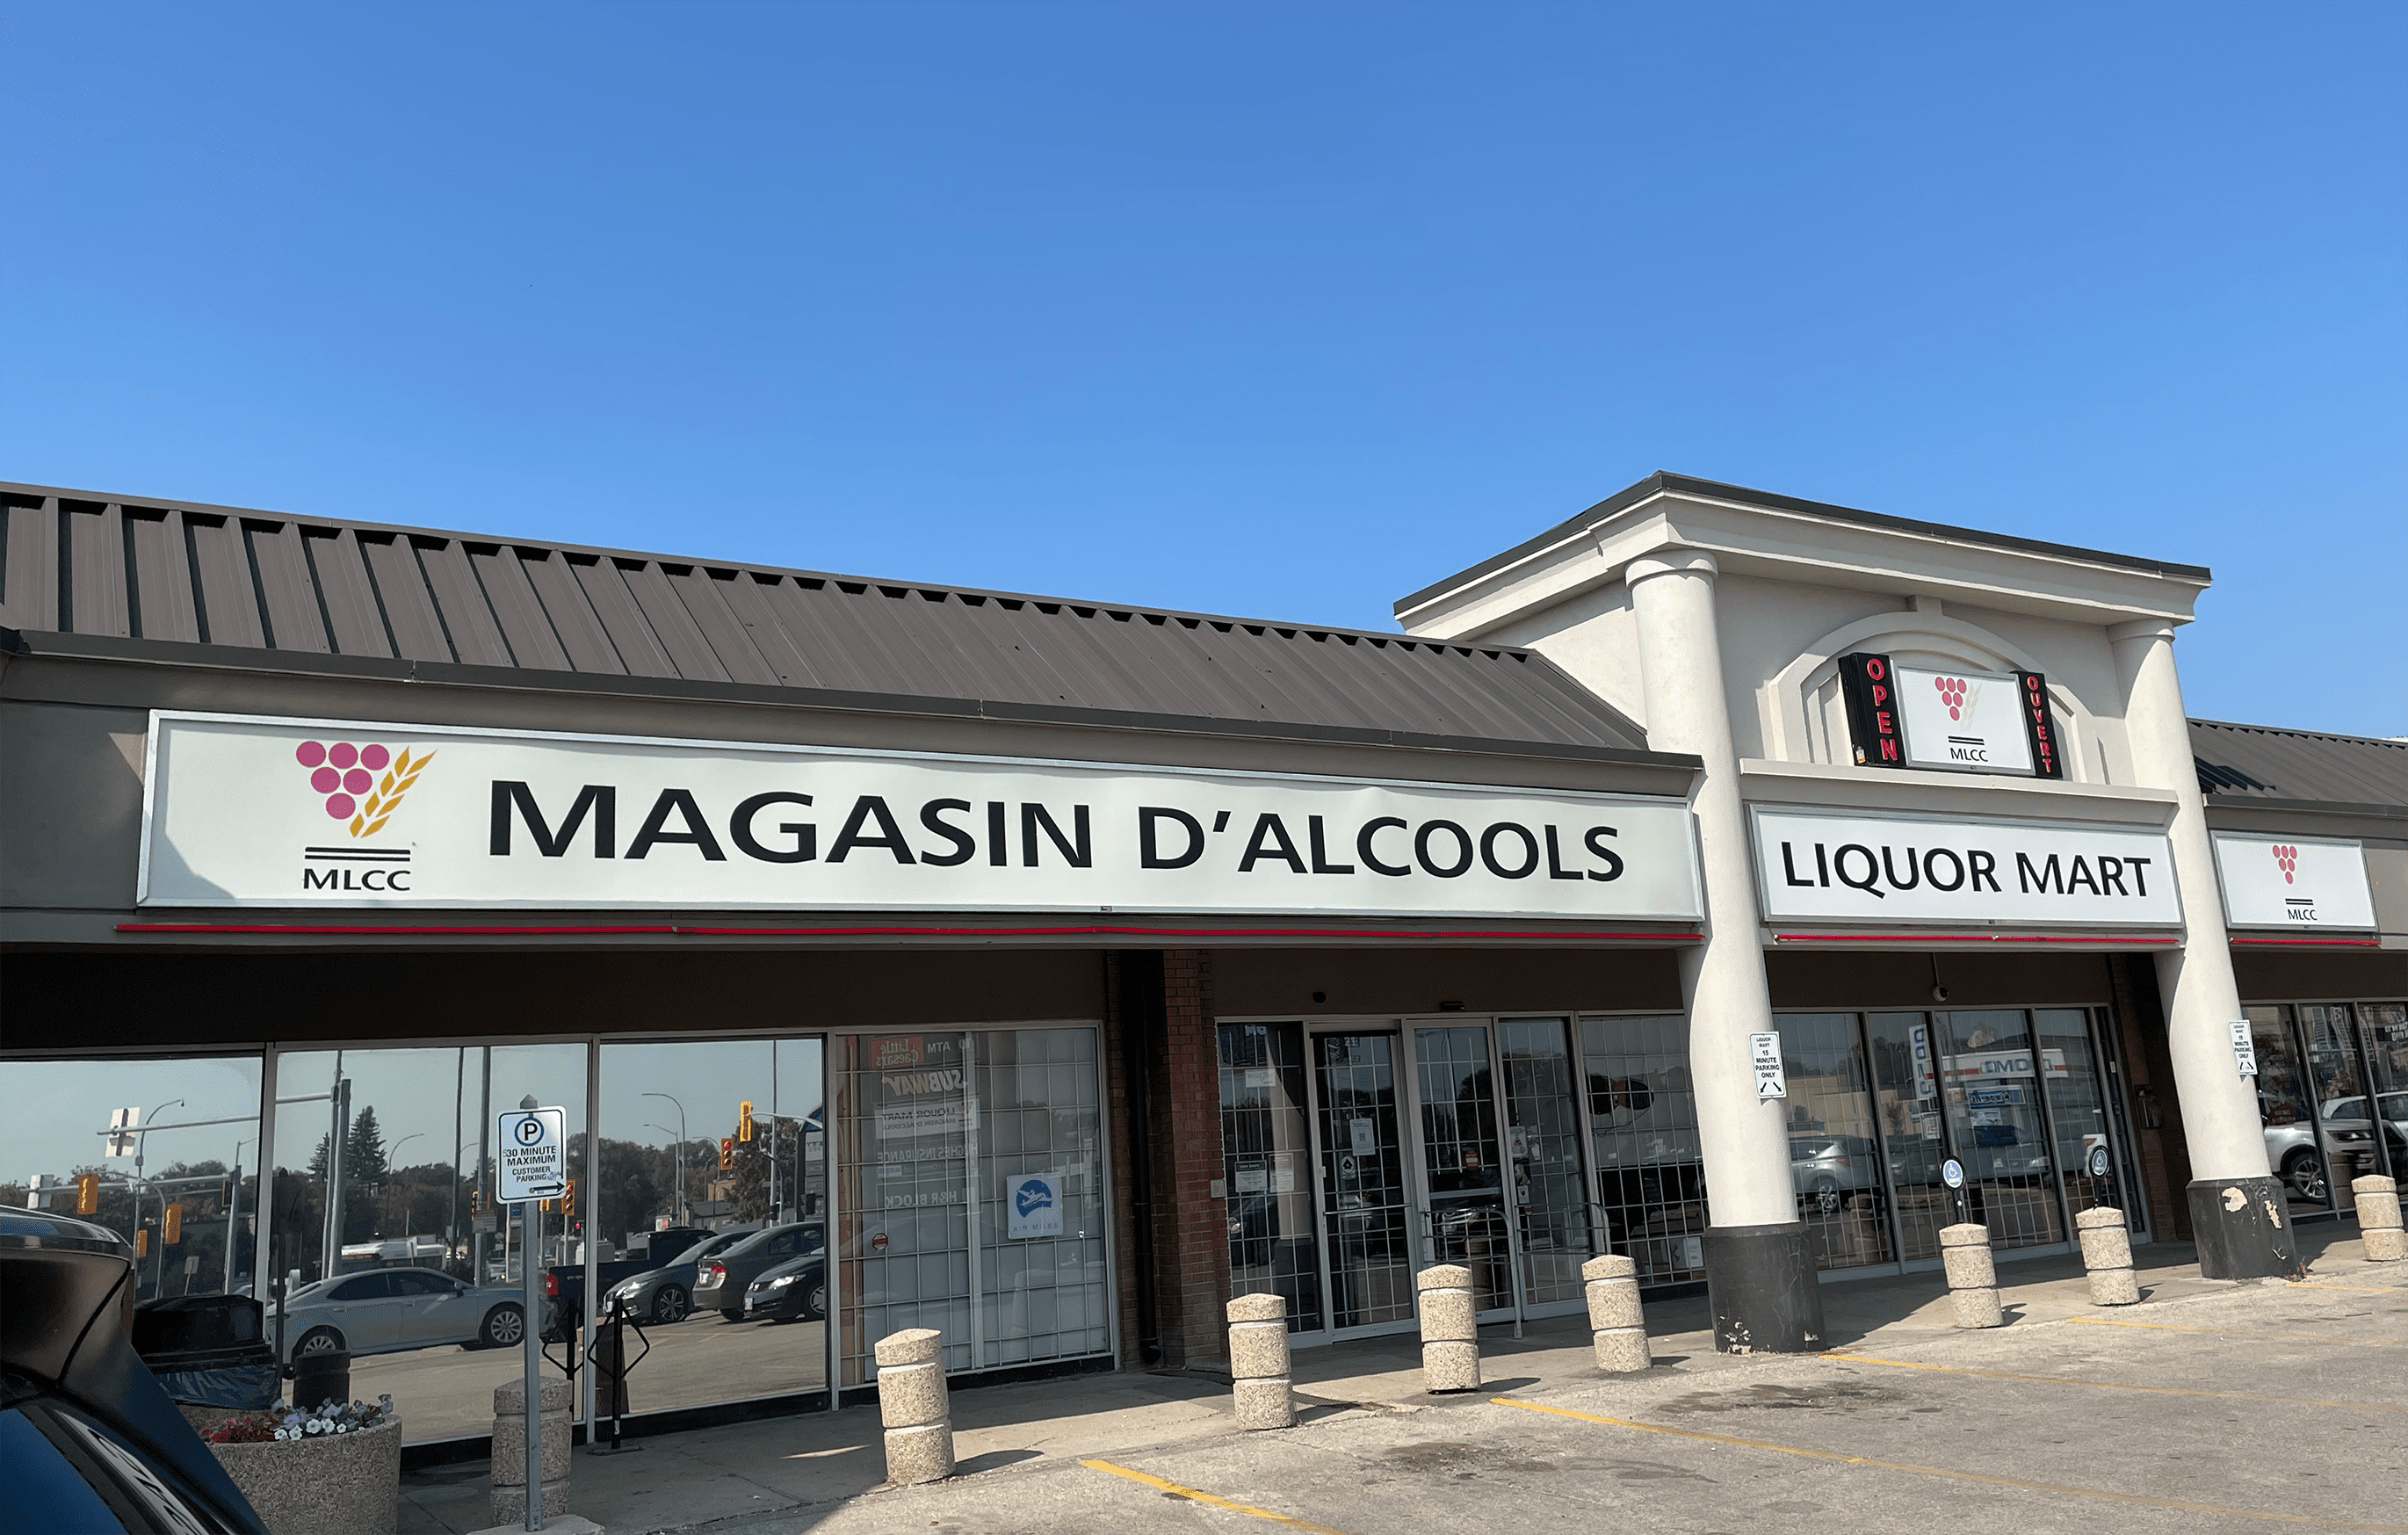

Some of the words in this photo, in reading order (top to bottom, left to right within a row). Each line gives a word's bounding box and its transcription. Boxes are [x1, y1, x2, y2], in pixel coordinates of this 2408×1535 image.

[1866, 657, 1898, 762] OPEN
[2026, 676, 2052, 774] OUVERT
[1949, 747, 1989, 763] MLCC
[489, 780, 1093, 868] MAGASIN
[1138, 806, 1625, 882] D'ALCOOLS
[1781, 841, 2002, 900] LIQUOR
[2015, 851, 2152, 897] MART
[303, 868, 411, 892] MLCC
[2287, 909, 2318, 921] MLCC
[524, 1122, 539, 1140] P
[520, 1146, 556, 1155] MINUTE
[507, 1155, 555, 1166] MAXIMUM
[512, 1166, 551, 1176] CUSTOMER
